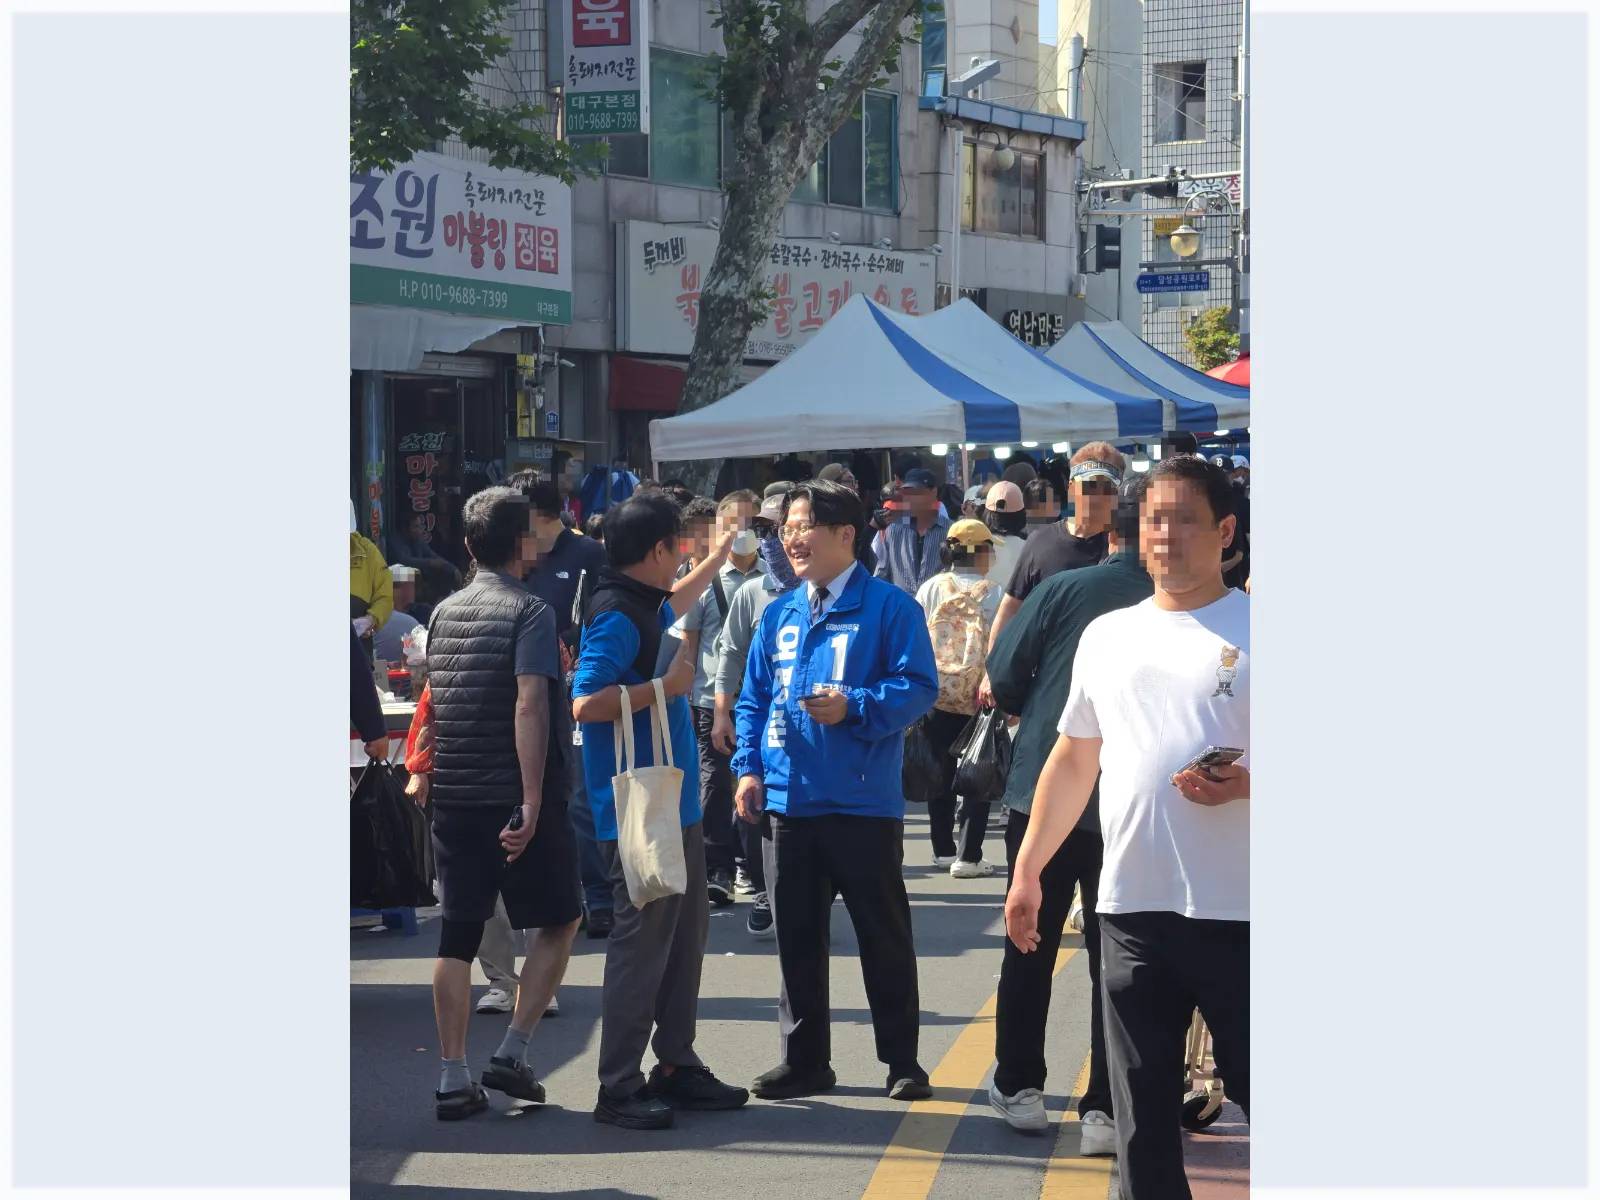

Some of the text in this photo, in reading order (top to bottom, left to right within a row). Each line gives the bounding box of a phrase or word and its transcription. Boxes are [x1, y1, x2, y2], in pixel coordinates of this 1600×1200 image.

[569, 54, 636, 86] 흑돼지전문
[571, 94, 635, 109] 대구본점
[568, 113, 638, 130] 010-9688-7399
[464, 171, 546, 216] 흑돼지전문
[517, 228, 556, 270] 정육
[643, 237, 686, 271] 두꺼비
[771, 243, 904, 274] 손칼국수 잔치국수 손수제비
[400, 279, 508, 308] H.P 010-9688-7399
[831, 633, 848, 681] 1
